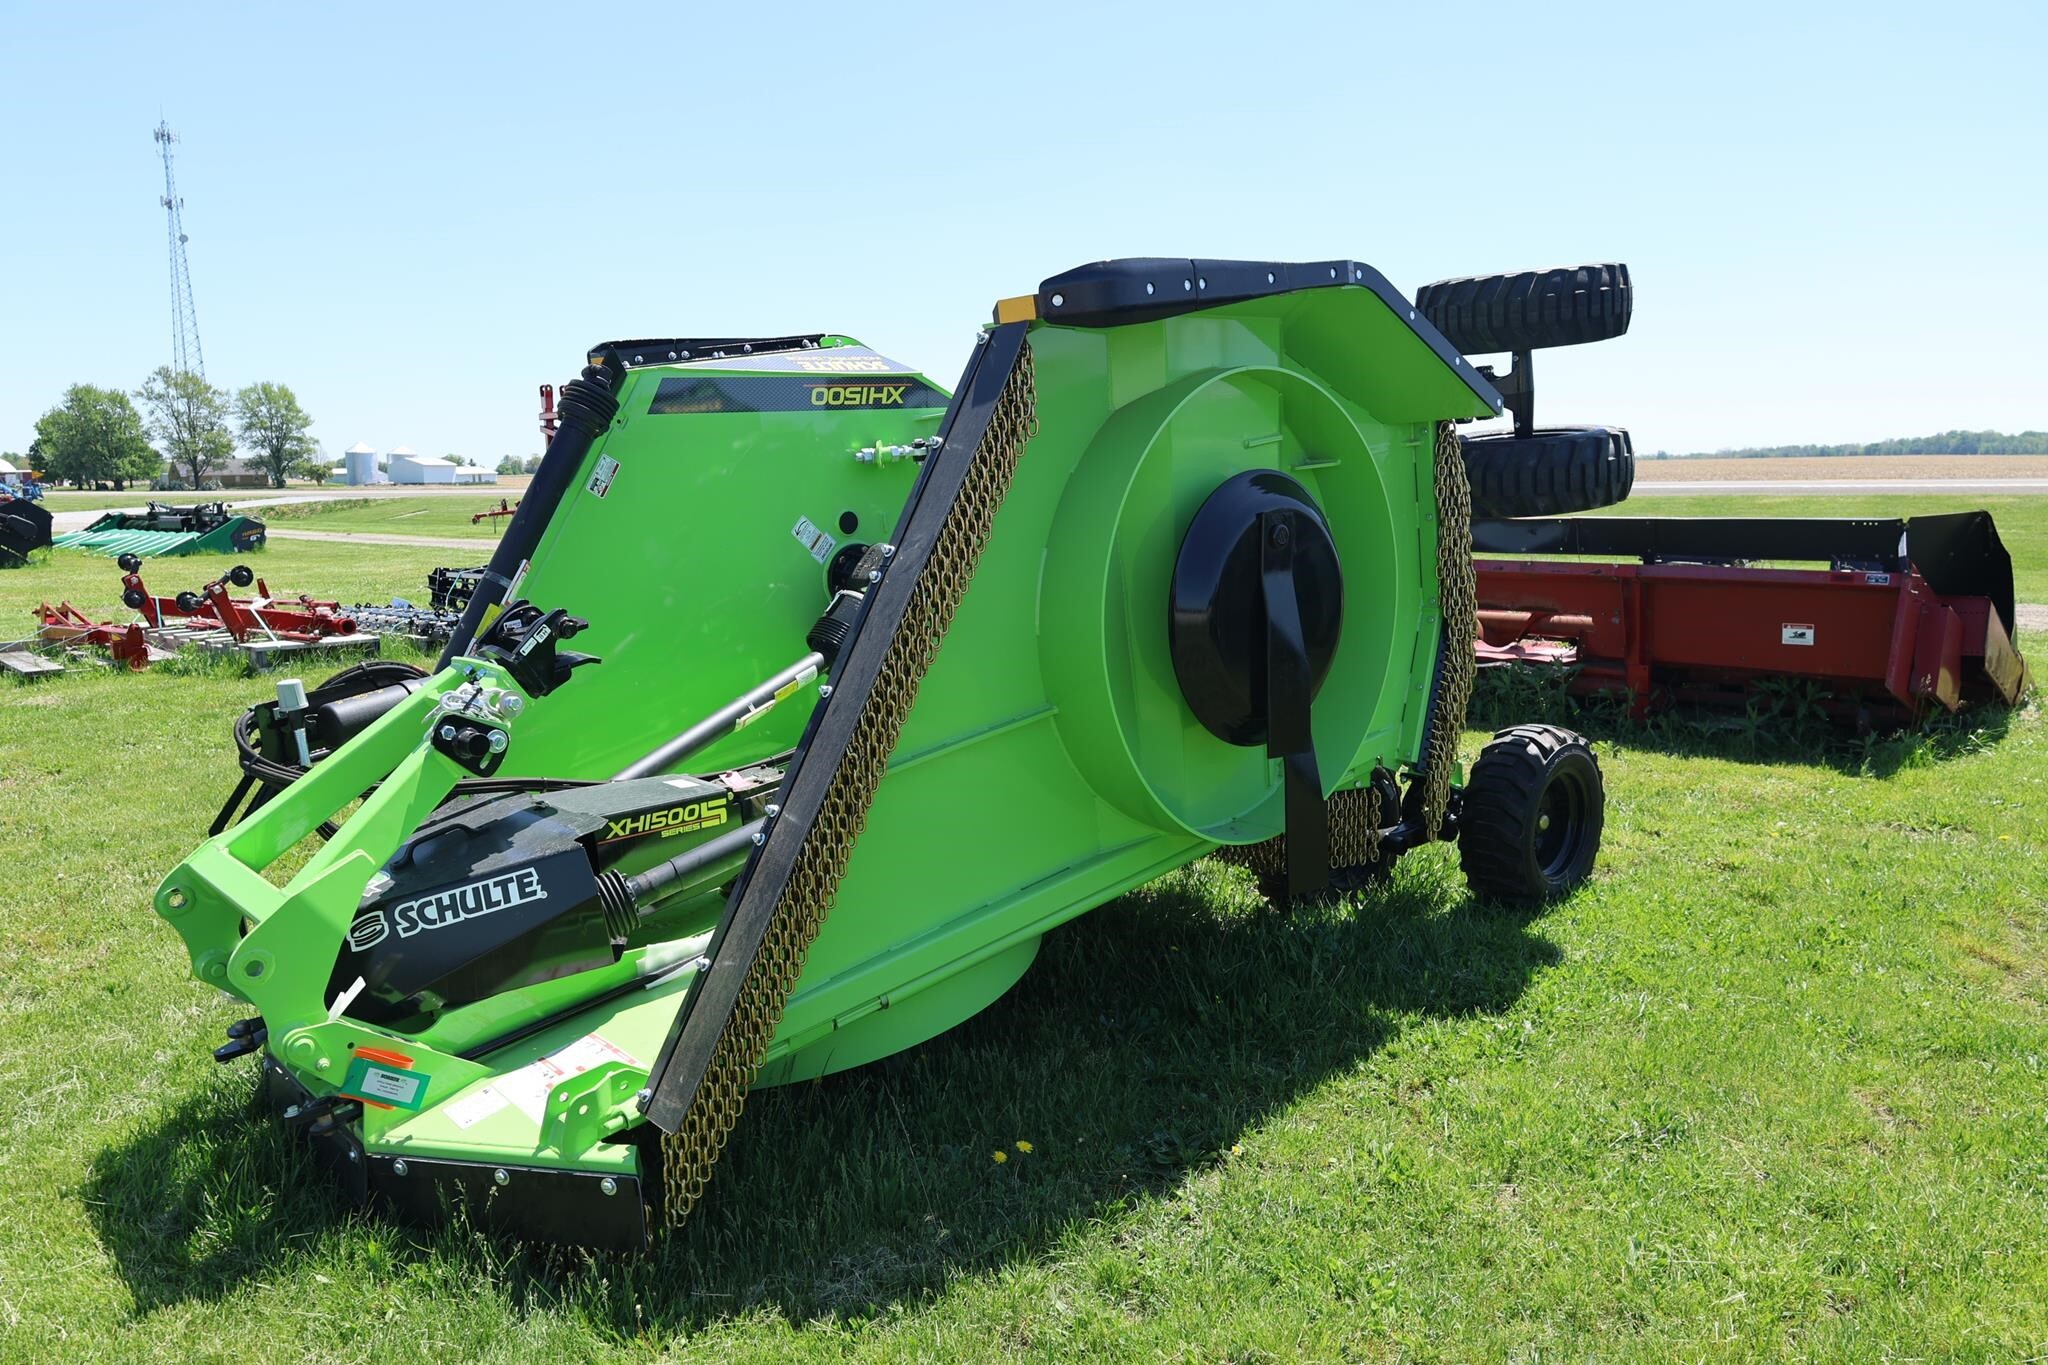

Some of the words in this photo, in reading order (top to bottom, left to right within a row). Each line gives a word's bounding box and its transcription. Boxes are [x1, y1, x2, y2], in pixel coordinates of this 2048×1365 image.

[811, 386, 905, 405] XH1500
[607, 804, 699, 839] XH1500
[661, 822, 701, 837] SERIES
[394, 867, 541, 939] SCHULTE
